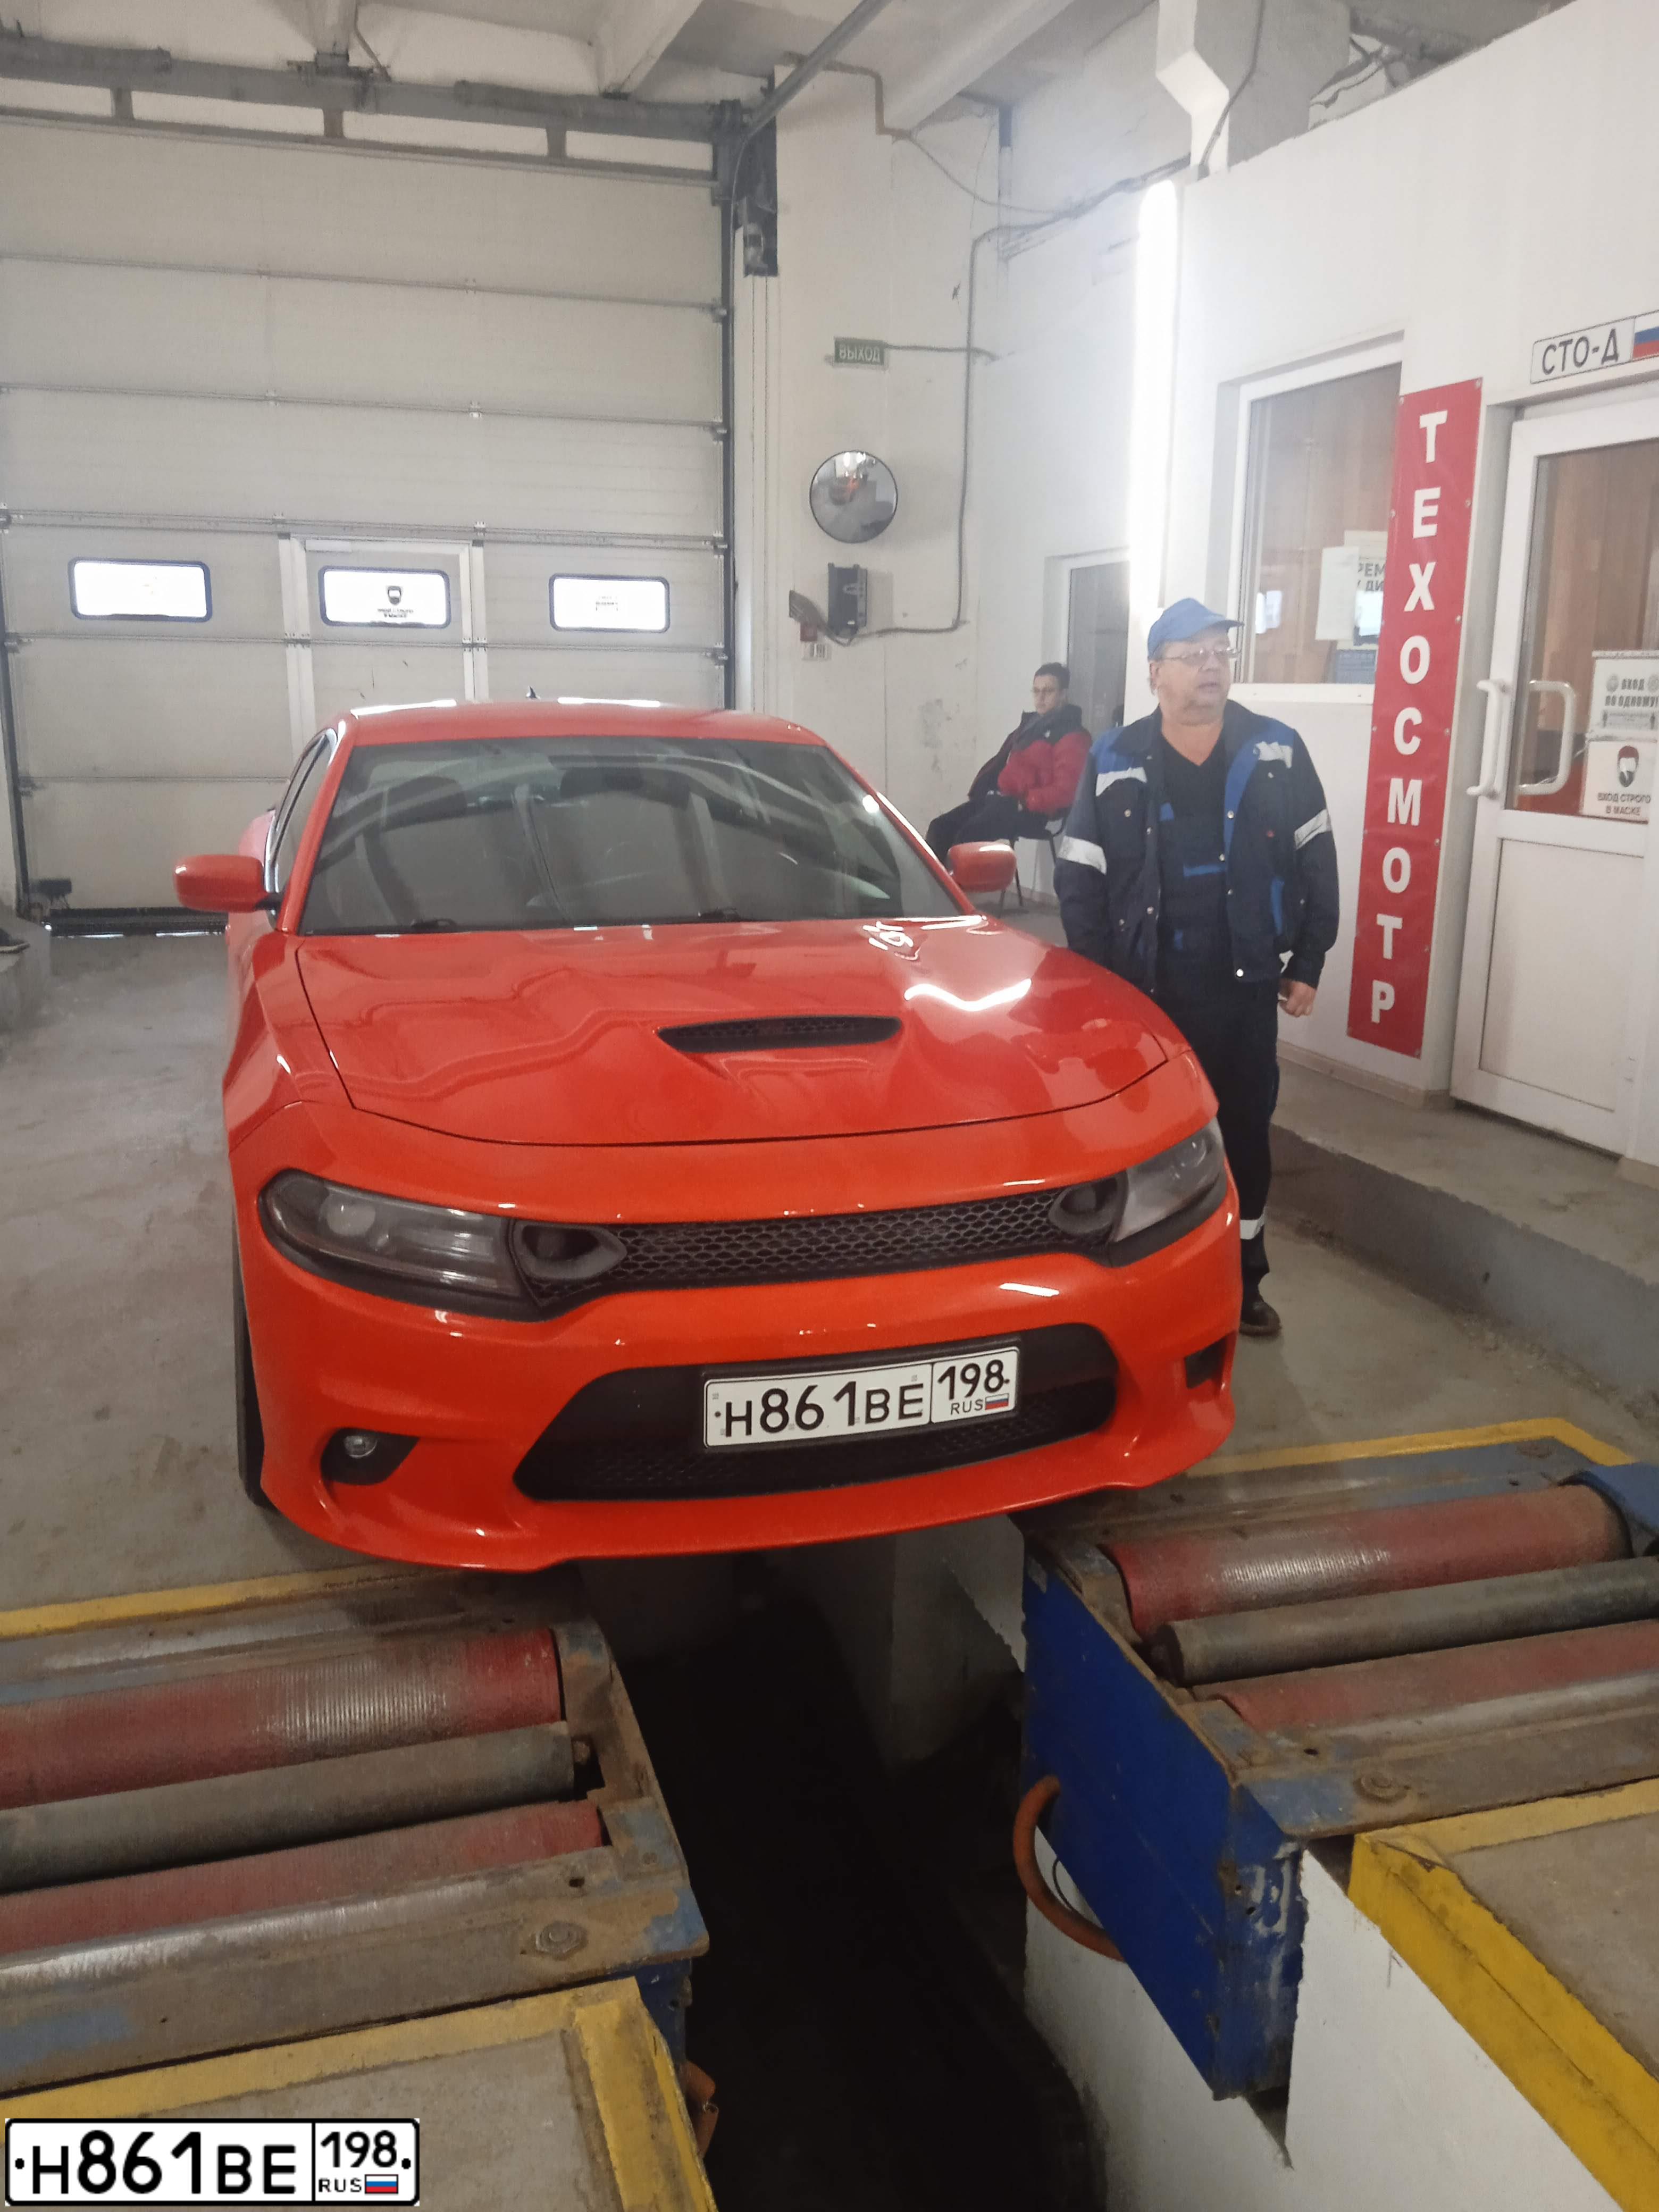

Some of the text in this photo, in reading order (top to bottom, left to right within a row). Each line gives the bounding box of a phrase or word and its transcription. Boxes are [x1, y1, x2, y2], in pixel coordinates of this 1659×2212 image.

[840, 343, 881, 363] ВЫХОД
[1541, 328, 1620, 375] СТО-Д
[1370, 410, 1448, 1024] ТЕХОСМОТР
[1597, 792, 1651, 803] ВХОД СТРОГО
[1613, 806, 1641, 816] МАСКЕ
[937, 1359, 1004, 1400] 198
[950, 1398, 984, 1415] RUS
